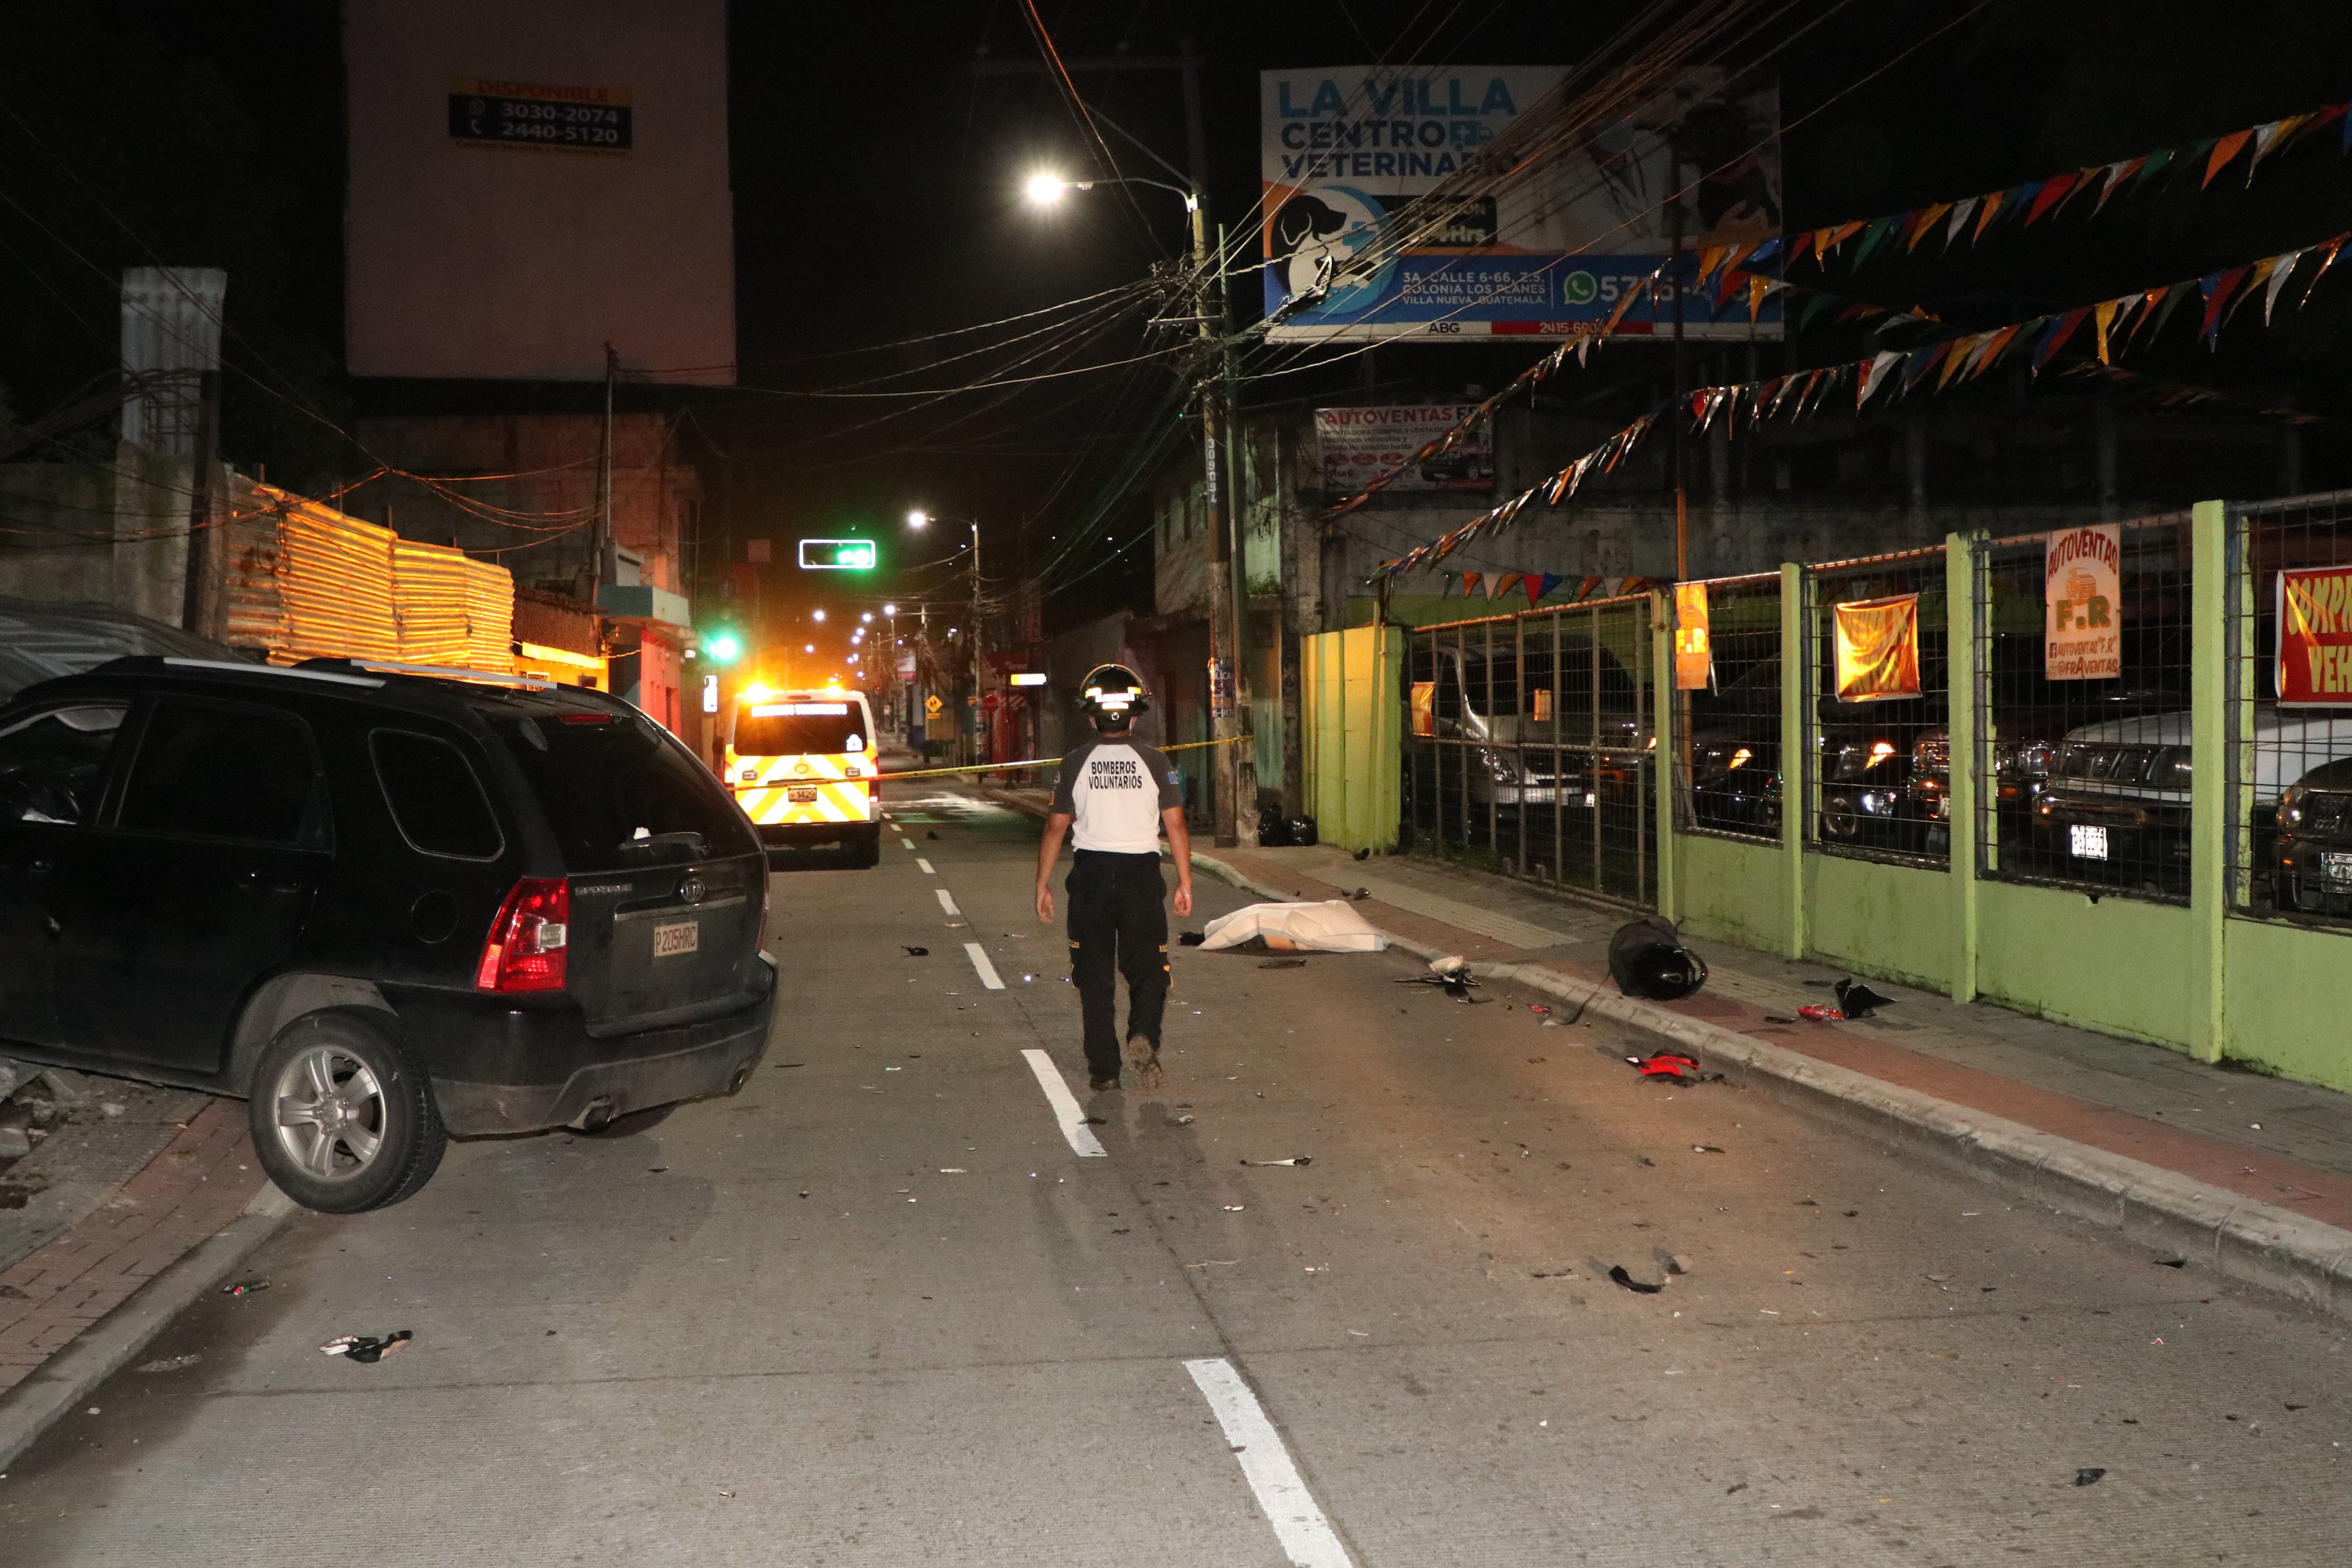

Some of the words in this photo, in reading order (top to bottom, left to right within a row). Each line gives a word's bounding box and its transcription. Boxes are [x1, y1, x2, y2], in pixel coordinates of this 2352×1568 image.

[1279, 79, 1348, 118] LA
[1364, 78, 1517, 117] VILLA
[501, 102, 619, 125] 3030-2074
[501, 121, 619, 144] 2440-5120
[1281, 120, 1446, 150] CENTRO
[1430, 272, 1475, 283] CALLE
[1480, 272, 1516, 284] 6-66,
[1403, 284, 1463, 295] COLONIA
[1468, 284, 1492, 295] LOS
[1496, 284, 1546, 294] PLANES
[1403, 296, 1434, 304] VILLA
[1428, 323, 1460, 334] ABG
[1325, 408, 1452, 425] AUTOVENTAS
[2047, 529, 2118, 584] AUTOVENTAS
[1092, 761, 1136, 775] BOMBEROS
[1089, 776, 1142, 789] VOLUNTARIOS
